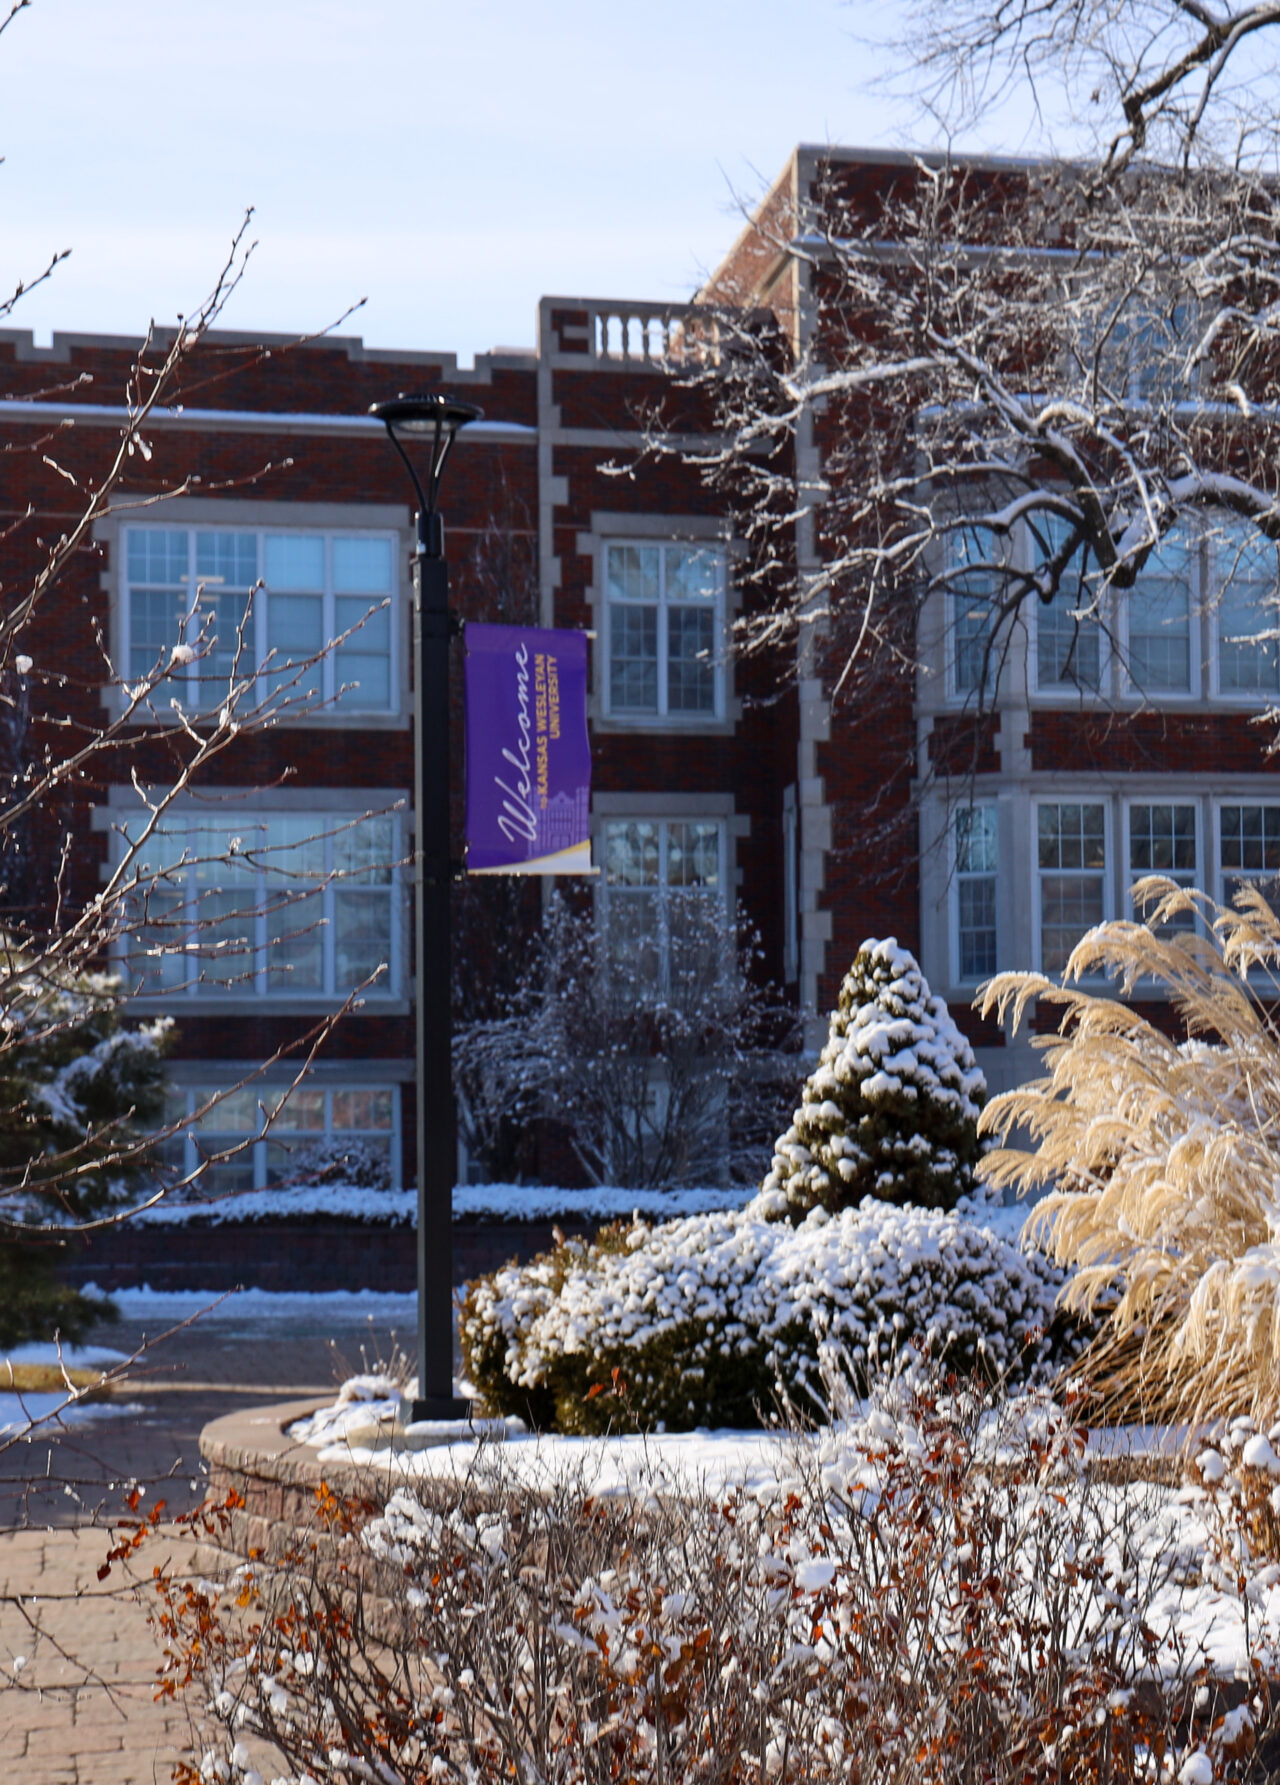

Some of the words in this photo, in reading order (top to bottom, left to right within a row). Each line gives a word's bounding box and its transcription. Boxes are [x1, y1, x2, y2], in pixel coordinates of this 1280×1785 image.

[535, 654, 548, 732] WESLEYAN
[548, 655, 560, 739] UNIVERSITY
[495, 643, 537, 842] Welcome
[537, 736, 548, 795] KANSAS
